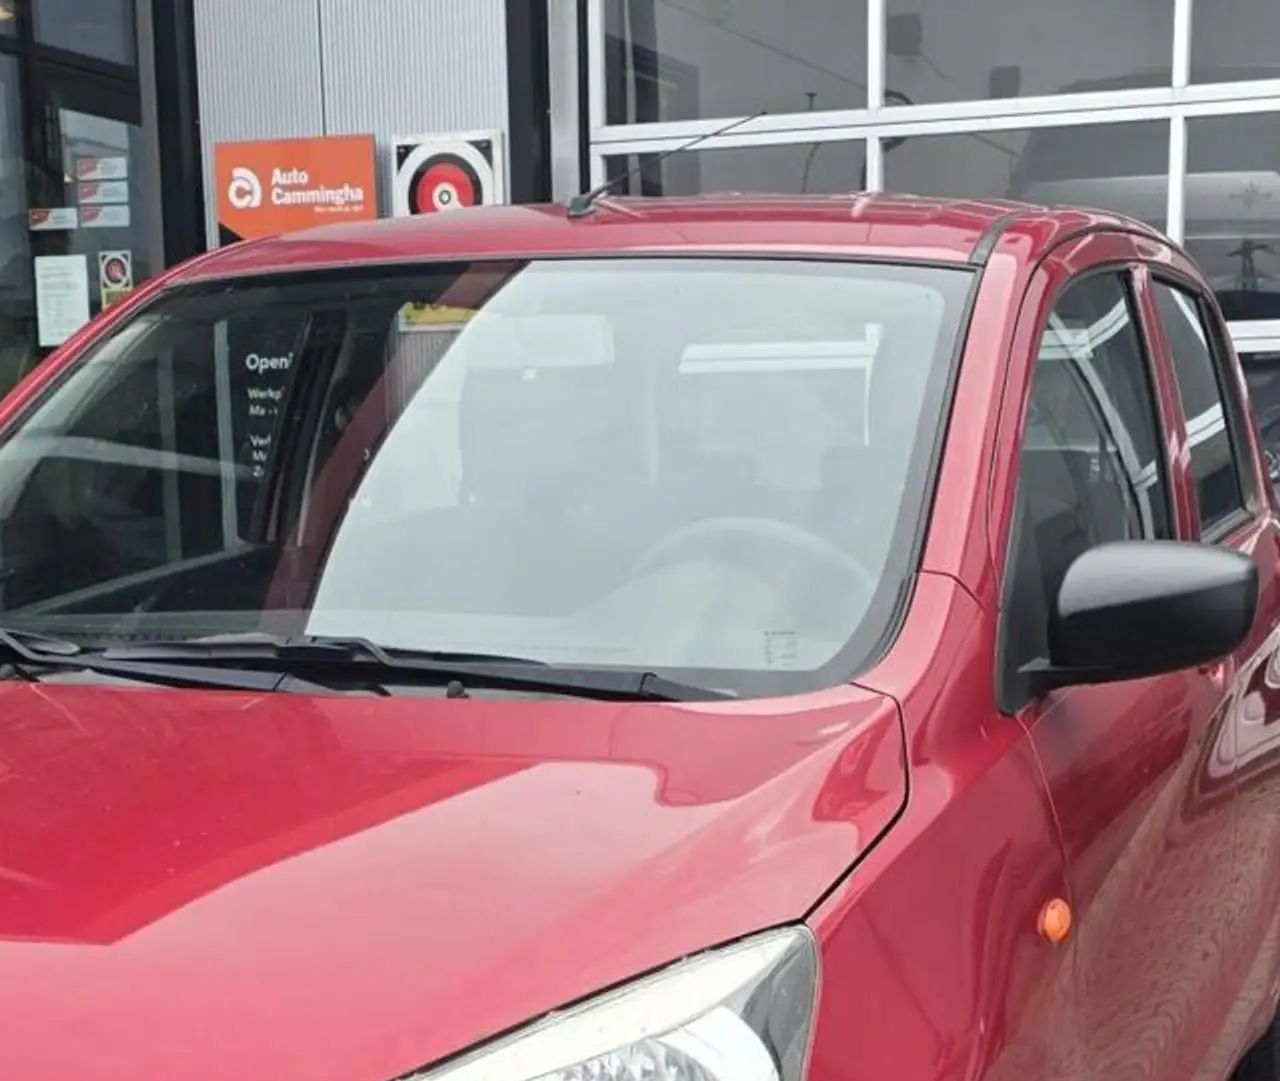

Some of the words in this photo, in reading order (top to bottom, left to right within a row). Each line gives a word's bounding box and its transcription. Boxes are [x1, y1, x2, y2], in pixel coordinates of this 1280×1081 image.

[271, 167, 309, 185] Auto
[271, 183, 364, 205] Cammingha
[247, 386, 286, 402] Werkp
